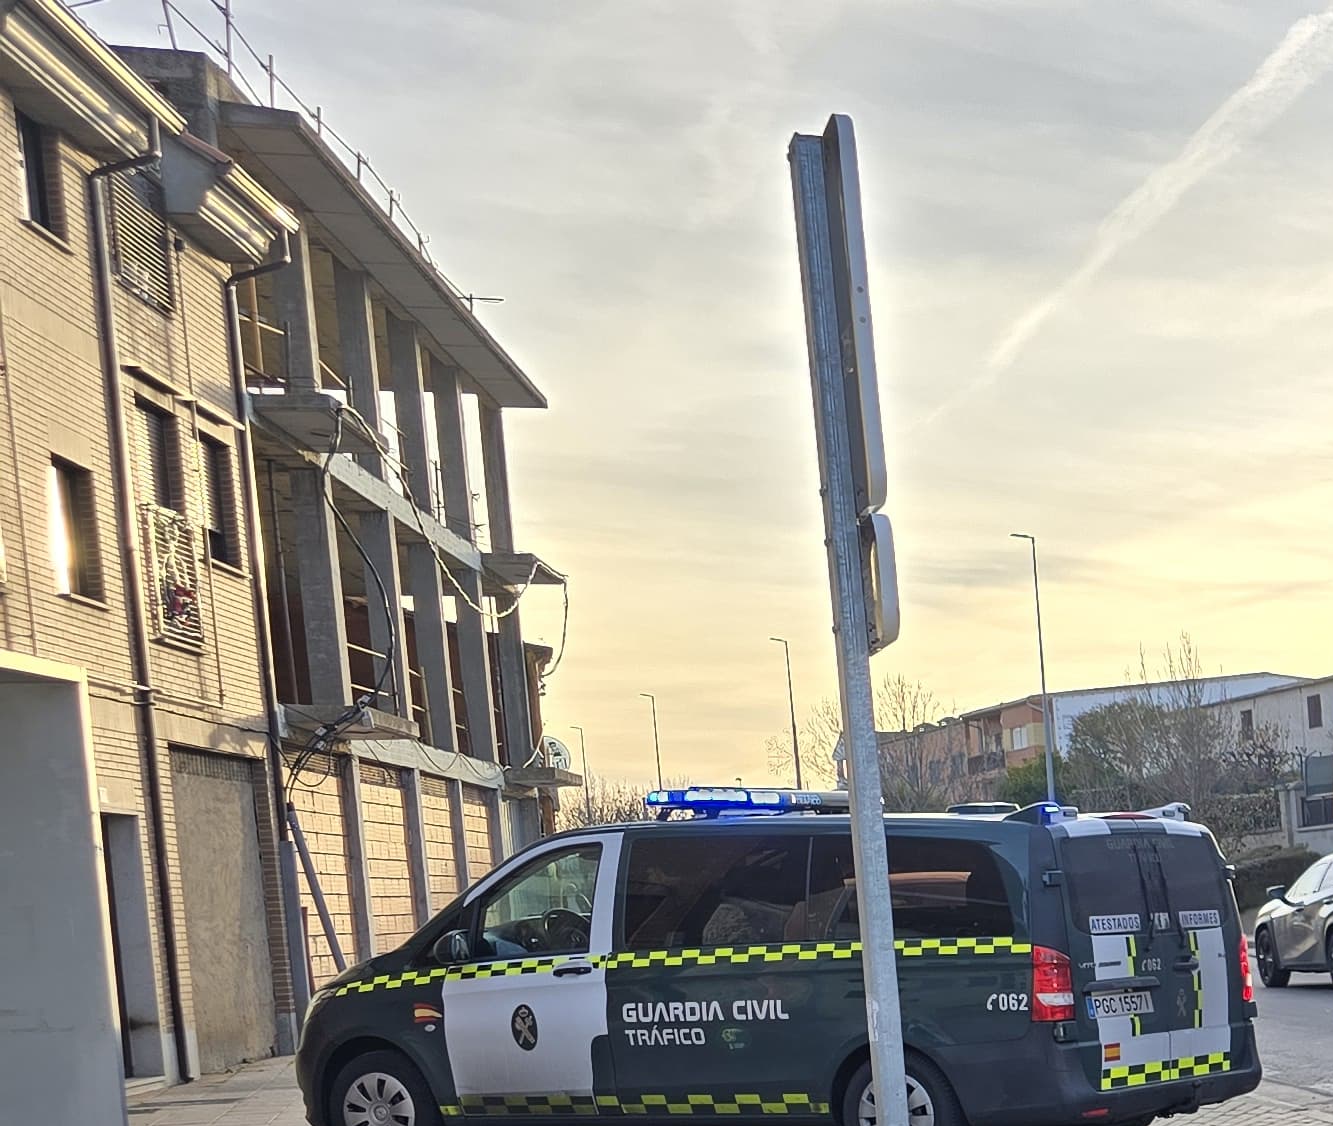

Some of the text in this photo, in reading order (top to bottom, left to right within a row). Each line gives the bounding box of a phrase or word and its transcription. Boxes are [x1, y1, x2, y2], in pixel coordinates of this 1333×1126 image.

[1091, 917, 1140, 931] ATESTADOS
[1182, 912, 1218, 925] INFORMES
[1147, 958, 1161, 972] 062
[999, 994, 1029, 1011] 062
[1094, 998, 1118, 1014] PGC
[622, 999, 790, 1023] GUARDIA CIVIL
[624, 1025, 706, 1046] TRÁFICO
